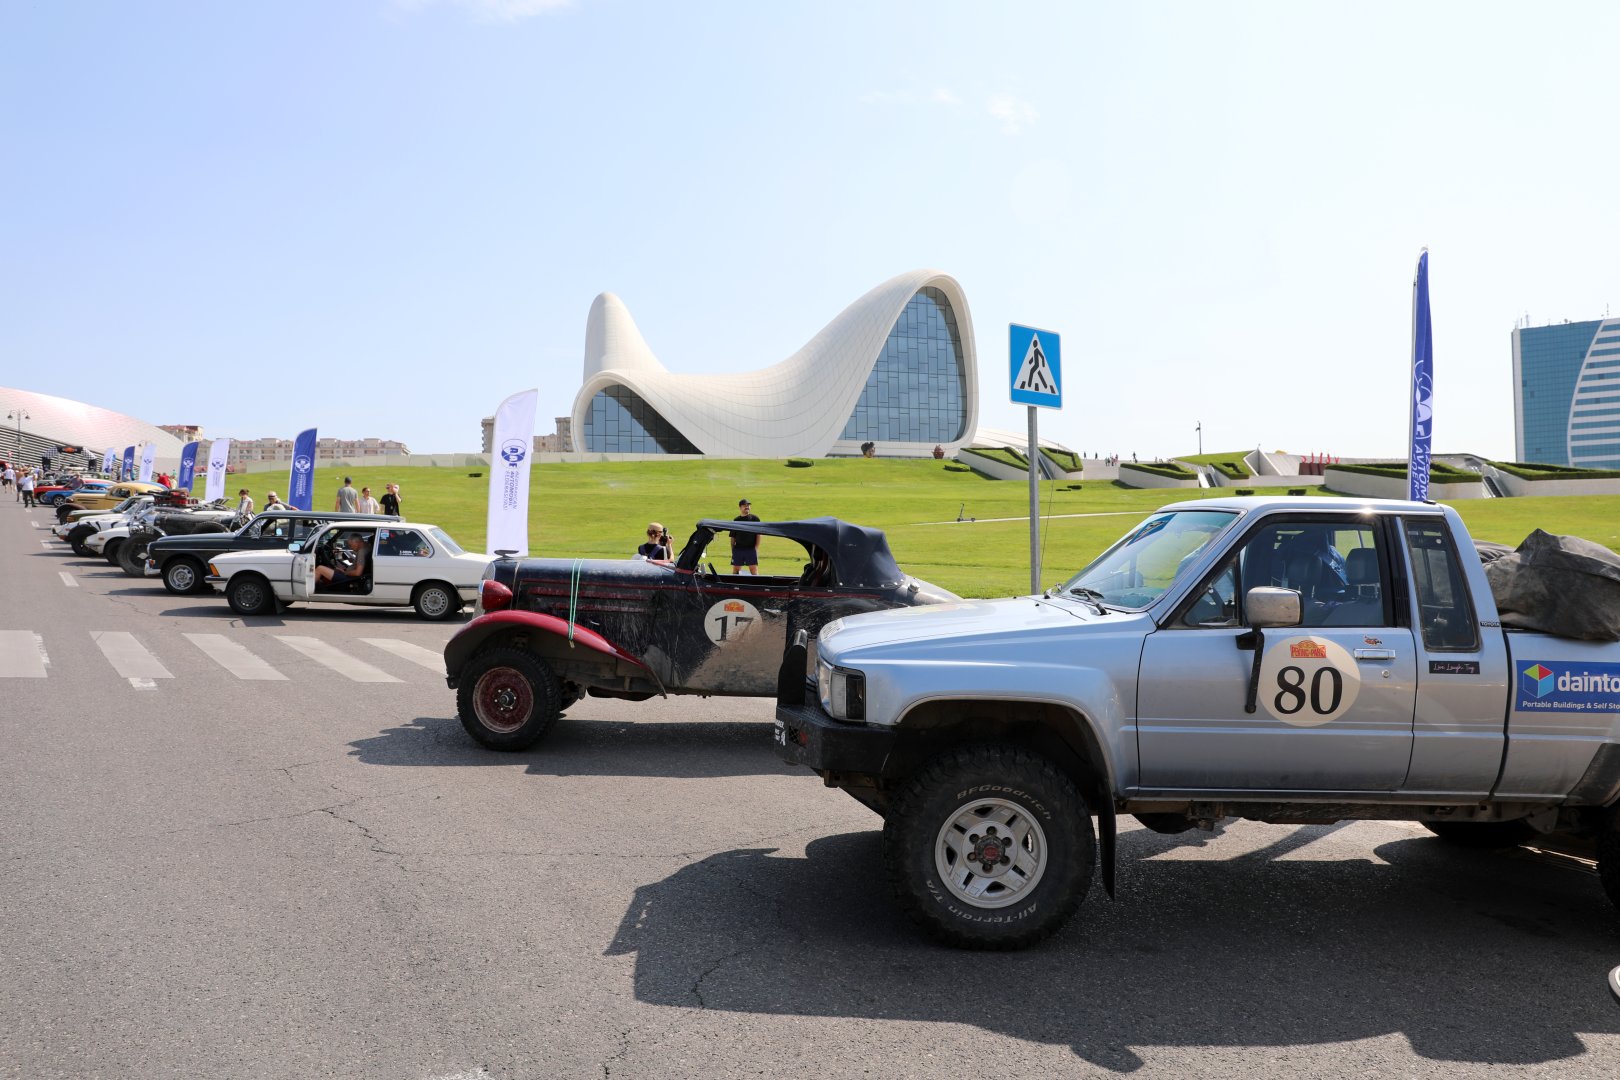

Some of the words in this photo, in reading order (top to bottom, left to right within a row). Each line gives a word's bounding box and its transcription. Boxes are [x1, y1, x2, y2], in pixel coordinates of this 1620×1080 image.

[715, 615, 754, 643] 17
[1274, 665, 1343, 715] 80
[1553, 702, 1585, 710] Buildings
[956, 784, 1052, 820] BFGoodrich
